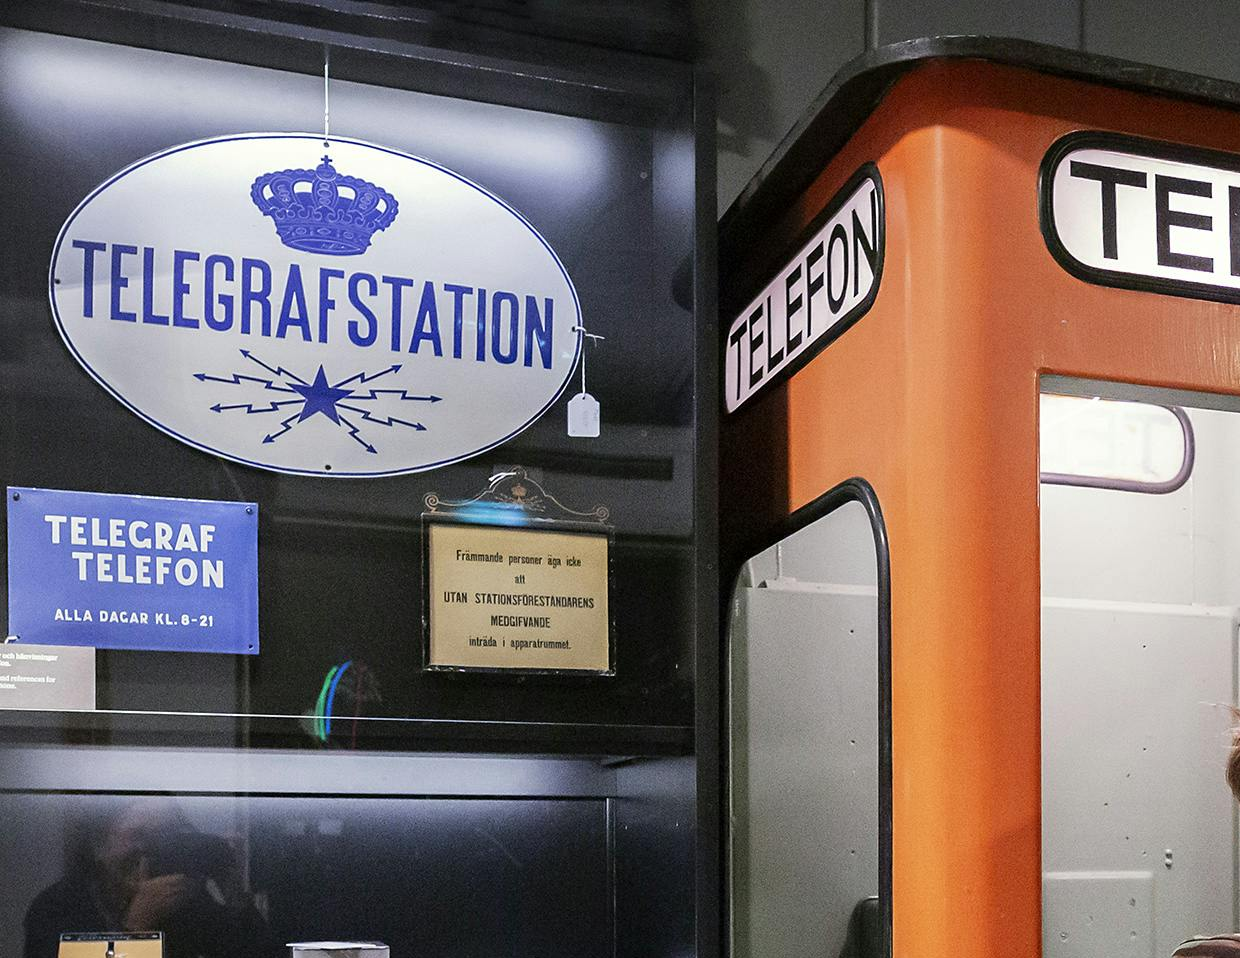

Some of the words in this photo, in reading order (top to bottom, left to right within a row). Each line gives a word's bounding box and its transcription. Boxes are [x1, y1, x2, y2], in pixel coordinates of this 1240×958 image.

[730, 189, 878, 401] TELEFON
[72, 239, 555, 370] TELEGRAFSTATION
[45, 515, 215, 552] TELEGRAF
[456, 550, 503, 563] Främmande
[508, 552, 543, 566] personer
[547, 555, 561, 568] äga
[566, 555, 581, 567] icke
[72, 551, 224, 588] TELEFON
[514, 574, 525, 584] att
[443, 591, 467, 603] UTAN
[54, 608, 93, 622] ALLA
[99, 610, 148, 624] DAGAR
[155, 613, 177, 625] KL.
[181, 614, 213, 627] 8-21
[490, 615, 551, 628] MEDGIFVANDE
[469, 635, 497, 647] inträda
[502, 636, 506, 647] i
[510, 637, 572, 650] apparatrummet.
